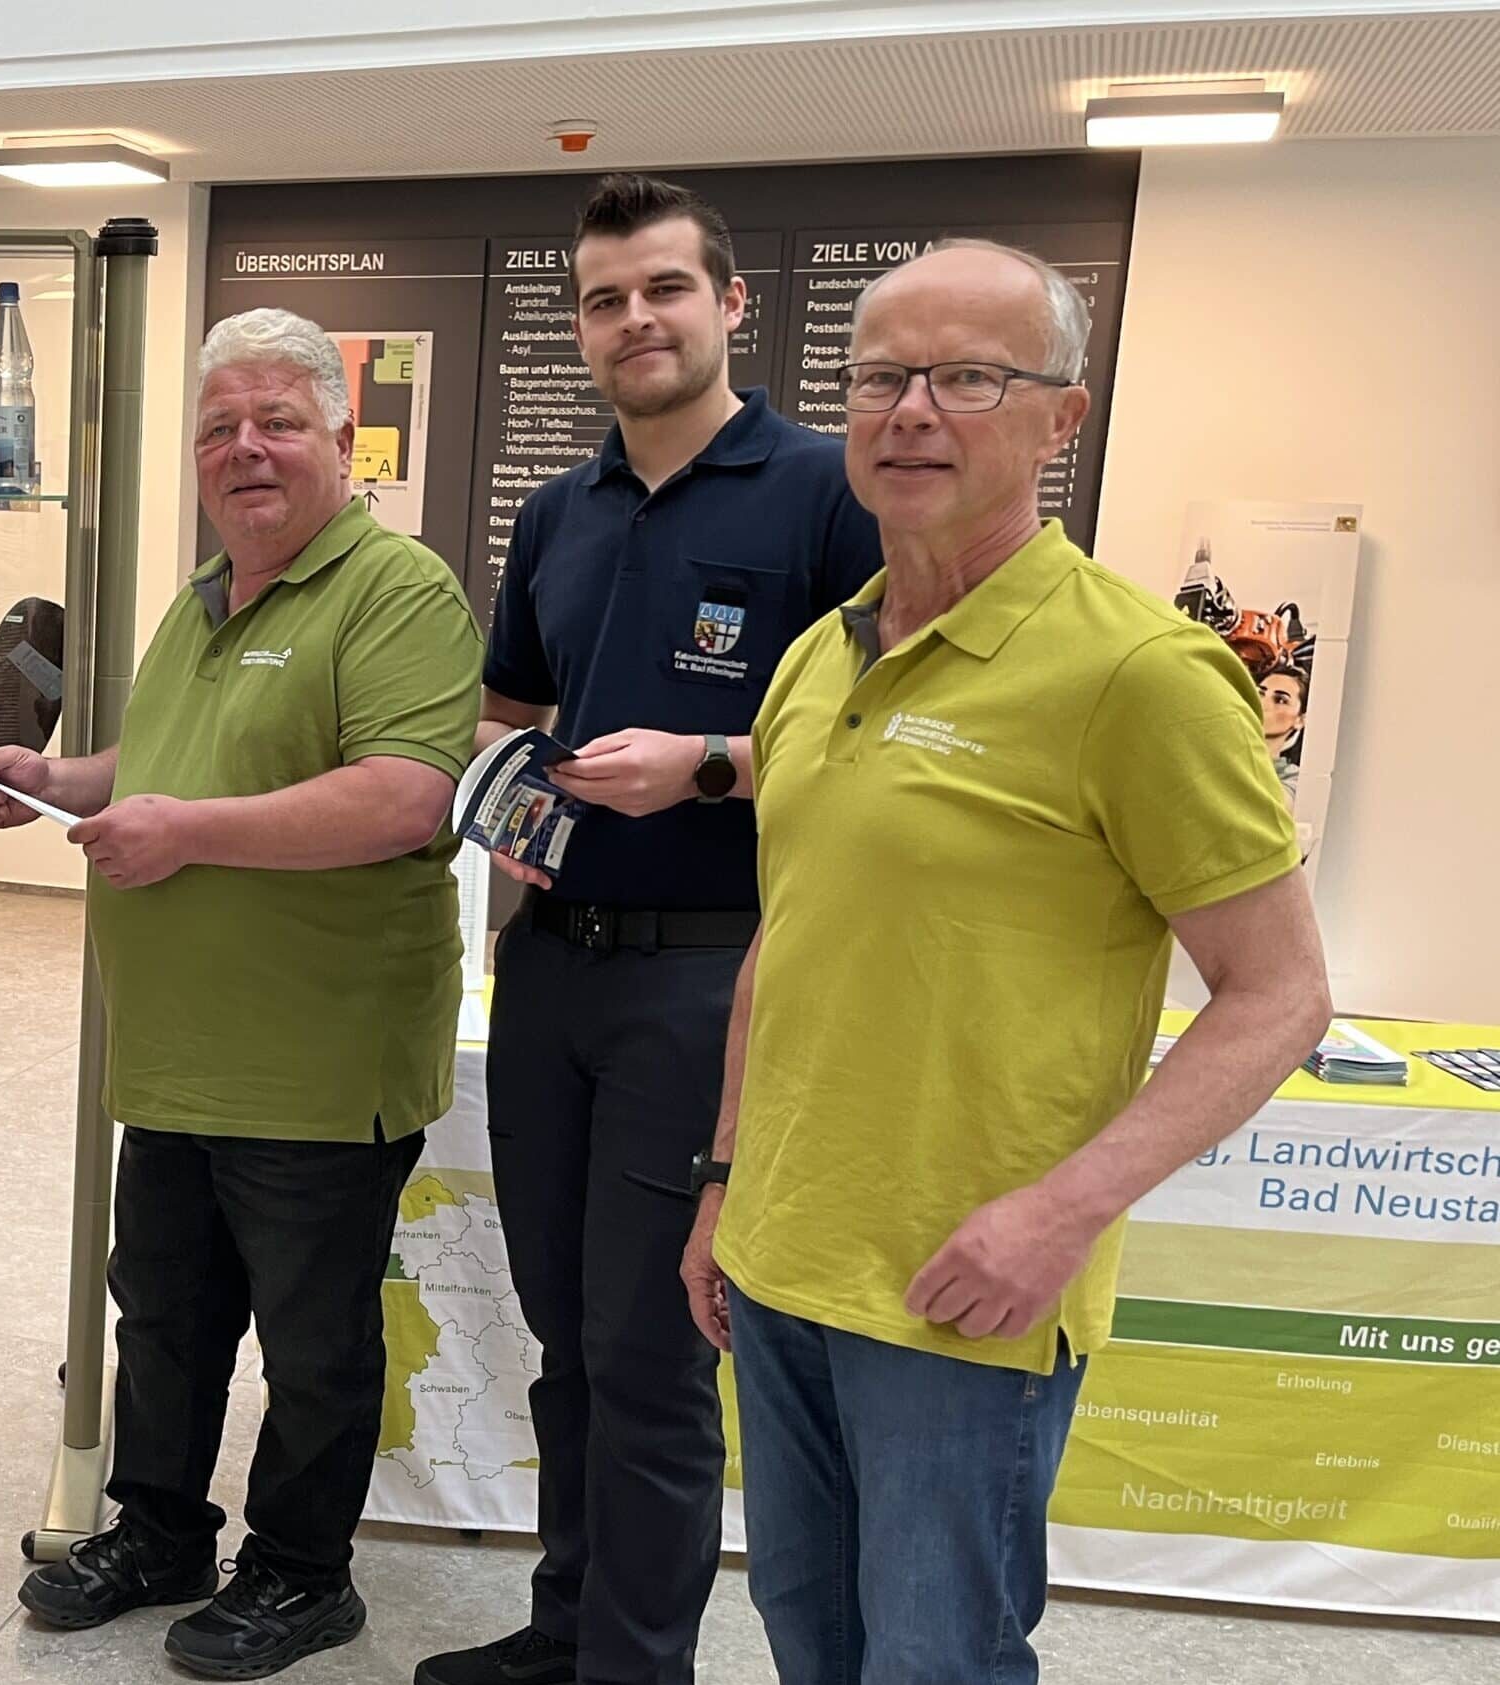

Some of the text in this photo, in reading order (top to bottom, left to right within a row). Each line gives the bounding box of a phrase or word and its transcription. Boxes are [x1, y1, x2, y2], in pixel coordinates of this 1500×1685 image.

[506, 250, 557, 268] ZIELE
[812, 243, 868, 262] ZIELE
[874, 241, 917, 261] VON
[236, 252, 384, 272] ÜBERSICHTSPLAN
[505, 283, 561, 295] Amtsleitung
[515, 297, 549, 308] Landrat
[502, 330, 576, 342] Ausländerbehör
[400, 361, 413, 379] E
[499, 363, 590, 375] Bauen und Wohnen
[378, 459, 392, 476] A
[1249, 1132, 1500, 1178] Landwirtsch
[1259, 1178, 1500, 1223] Bad Neusta
[393, 1229, 441, 1240] erfranken
[425, 1282, 492, 1297] Mittelfranken
[1340, 1325, 1500, 1361] Mit uns ge
[420, 1383, 470, 1394] Schwaben
[1277, 1373, 1352, 1395] Erholung
[1074, 1402, 1219, 1429] ebensqualität
[1437, 1433, 1500, 1457] Dienst
[1315, 1452, 1379, 1470] Erlebnis
[1120, 1482, 1349, 1525] Nachhaltigkeit
[1446, 1512, 1500, 1532] Qualif
